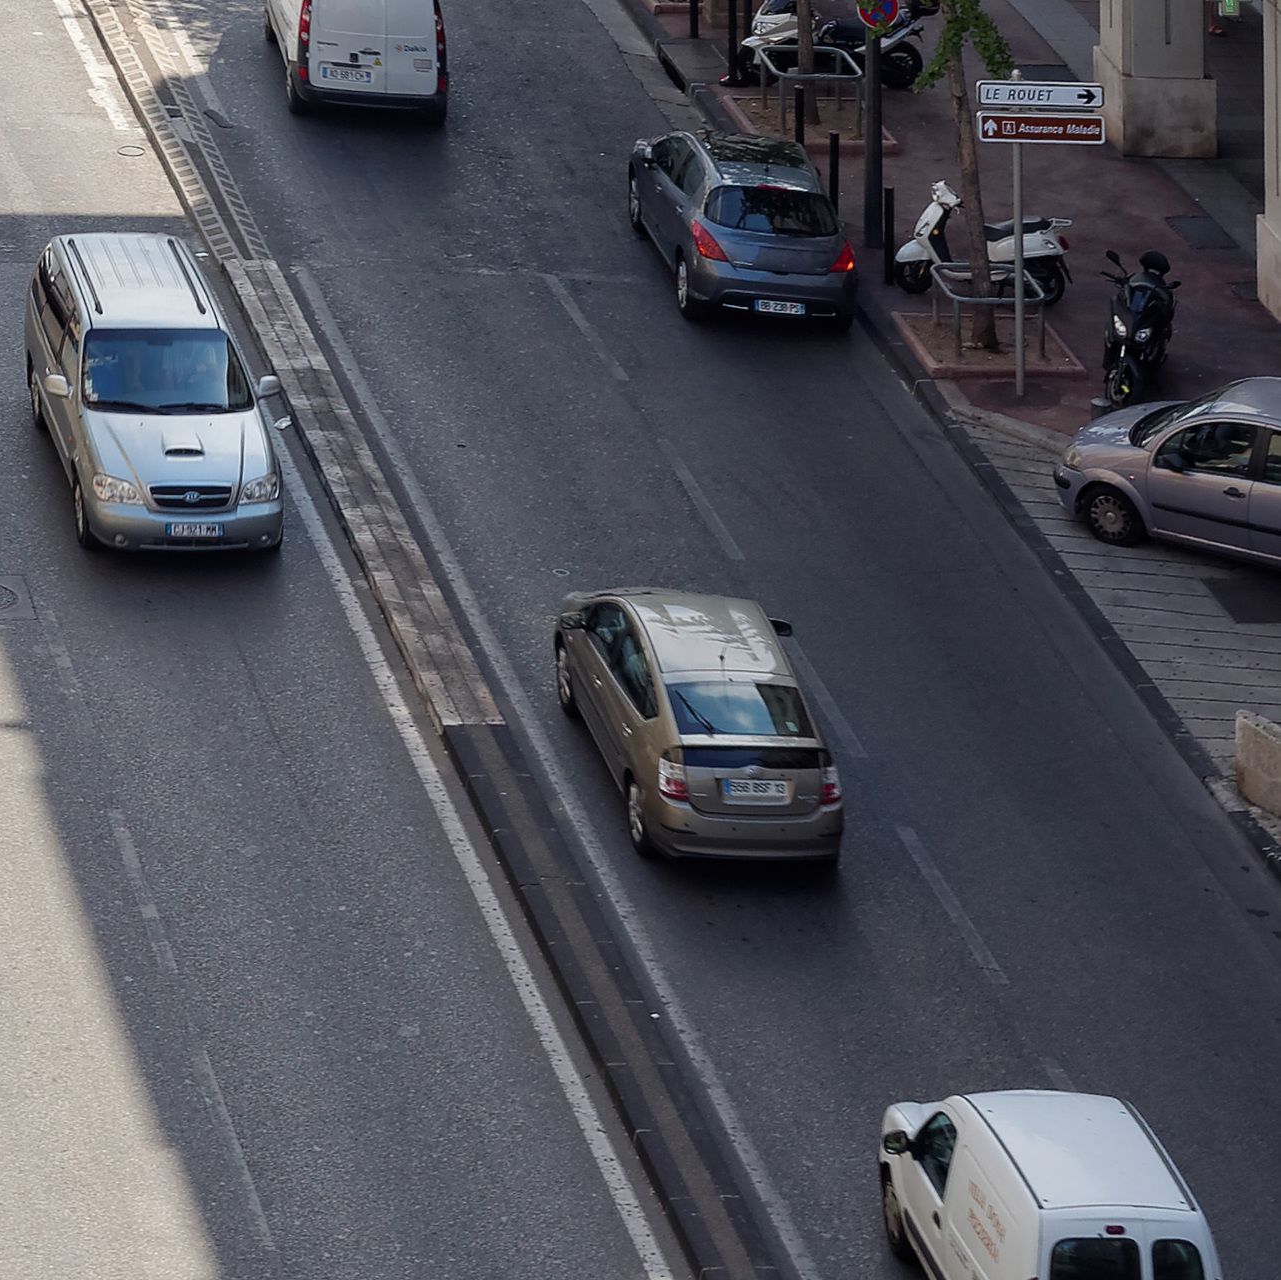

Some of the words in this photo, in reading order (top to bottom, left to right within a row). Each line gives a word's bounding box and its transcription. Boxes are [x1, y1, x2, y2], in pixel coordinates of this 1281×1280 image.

[985, 89, 999, 100] LE
[1008, 90, 1053, 101] ROUET
[1018, 123, 1063, 134] Assurance
[1067, 124, 1100, 135] Maladie
